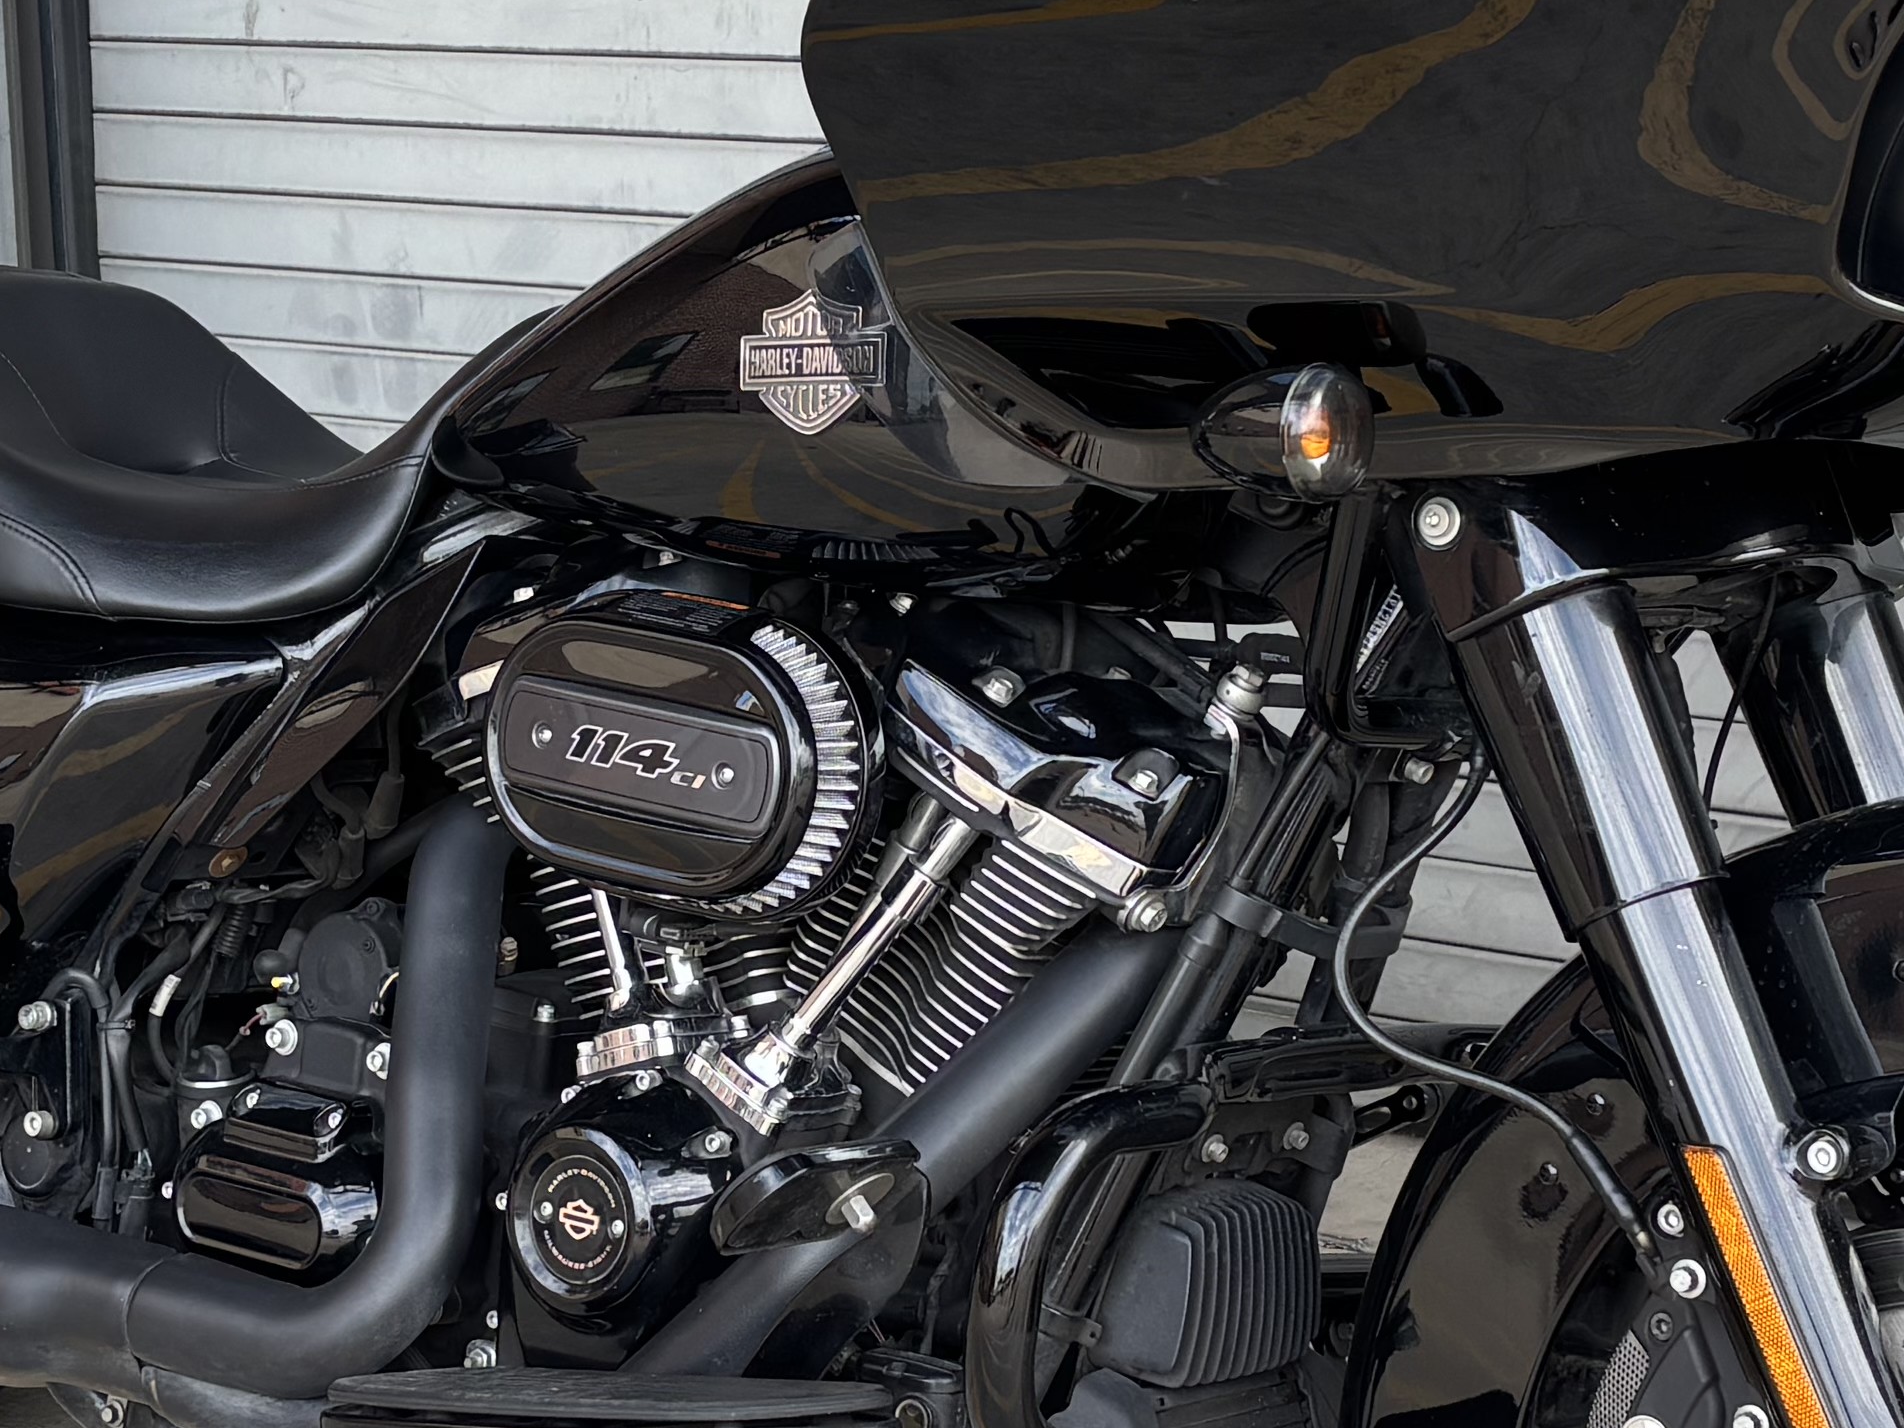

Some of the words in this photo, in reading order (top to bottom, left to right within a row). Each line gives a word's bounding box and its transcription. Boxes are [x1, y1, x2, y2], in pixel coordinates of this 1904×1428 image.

[750, 345, 874, 377] HARLEY-DAVIDSON
[778, 383, 842, 421] CYCLES
[565, 724, 681, 779] 114
